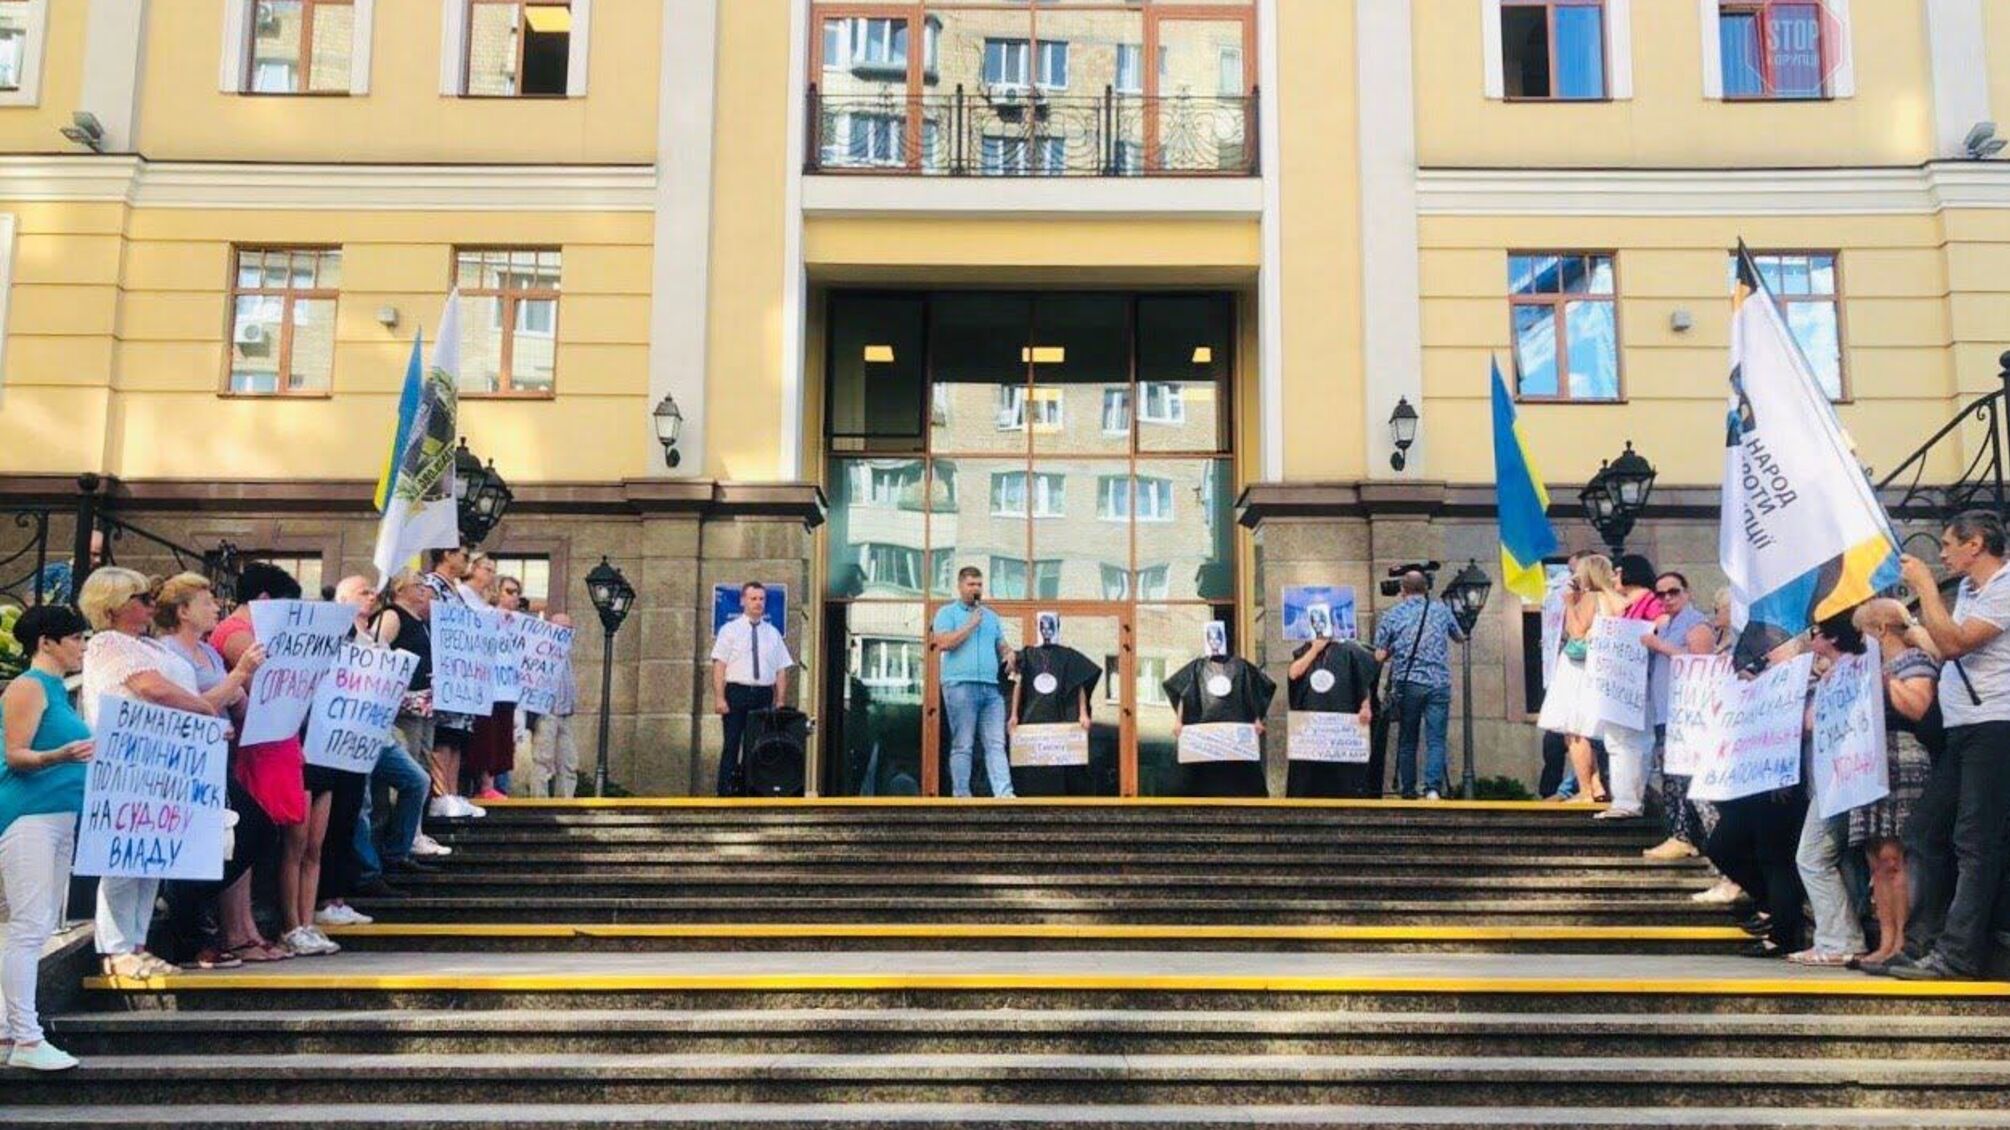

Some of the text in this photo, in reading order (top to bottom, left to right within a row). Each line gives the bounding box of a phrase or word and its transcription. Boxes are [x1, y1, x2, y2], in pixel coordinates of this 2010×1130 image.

[1743, 462, 1776, 515] РОТИ
[1746, 438, 1797, 508] НАРОД
[1744, 508, 1776, 549] ПЦІЇ
[337, 641, 410, 677] ГРОМА
[118, 701, 221, 744] ВИМАГАЄМО
[90, 799, 194, 832] НА СУДОВУ
[109, 836, 182, 872] ВЛАДУ
